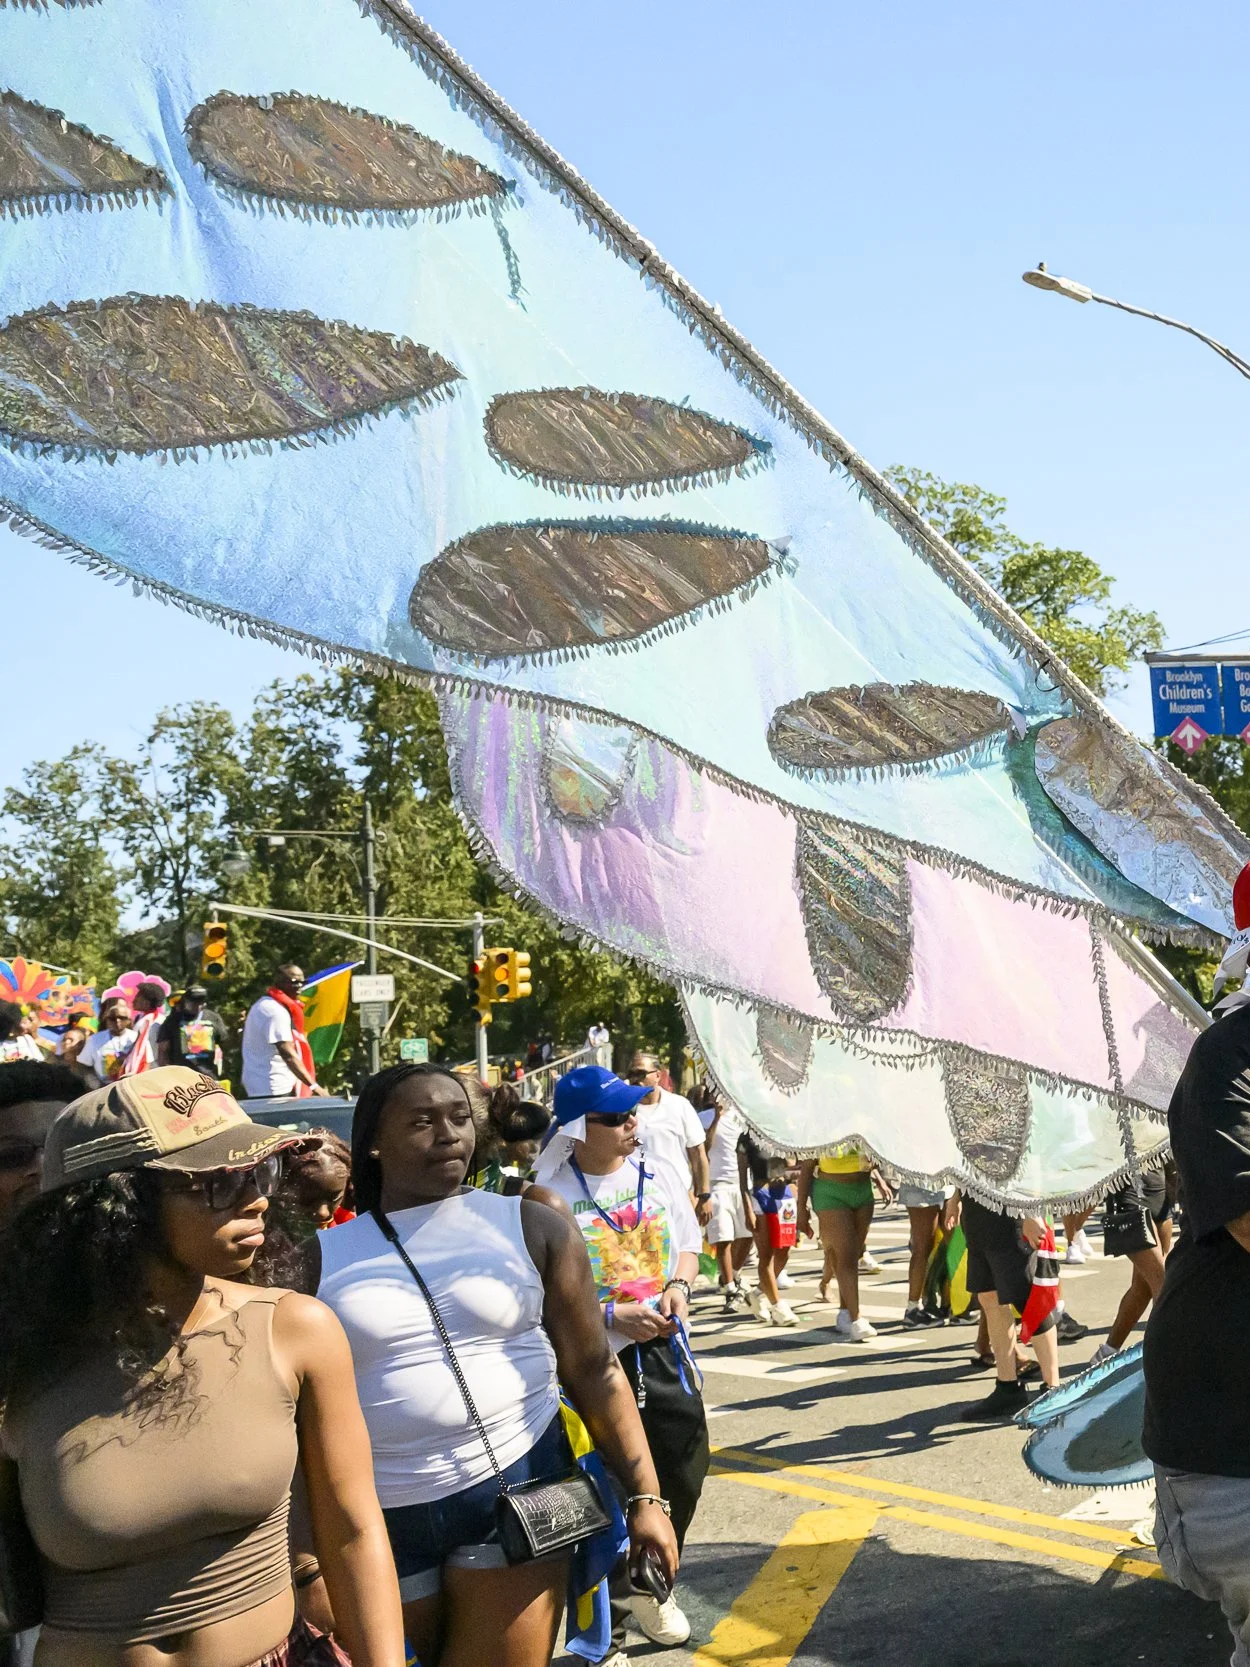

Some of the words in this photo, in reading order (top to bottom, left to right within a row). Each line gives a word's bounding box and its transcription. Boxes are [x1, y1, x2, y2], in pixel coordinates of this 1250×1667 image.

[1166, 670, 1203, 684] Brooklyn
[1159, 684, 1212, 701] Children's
[1169, 701, 1205, 714] Museum
[228, 1132, 289, 1162] Indian
